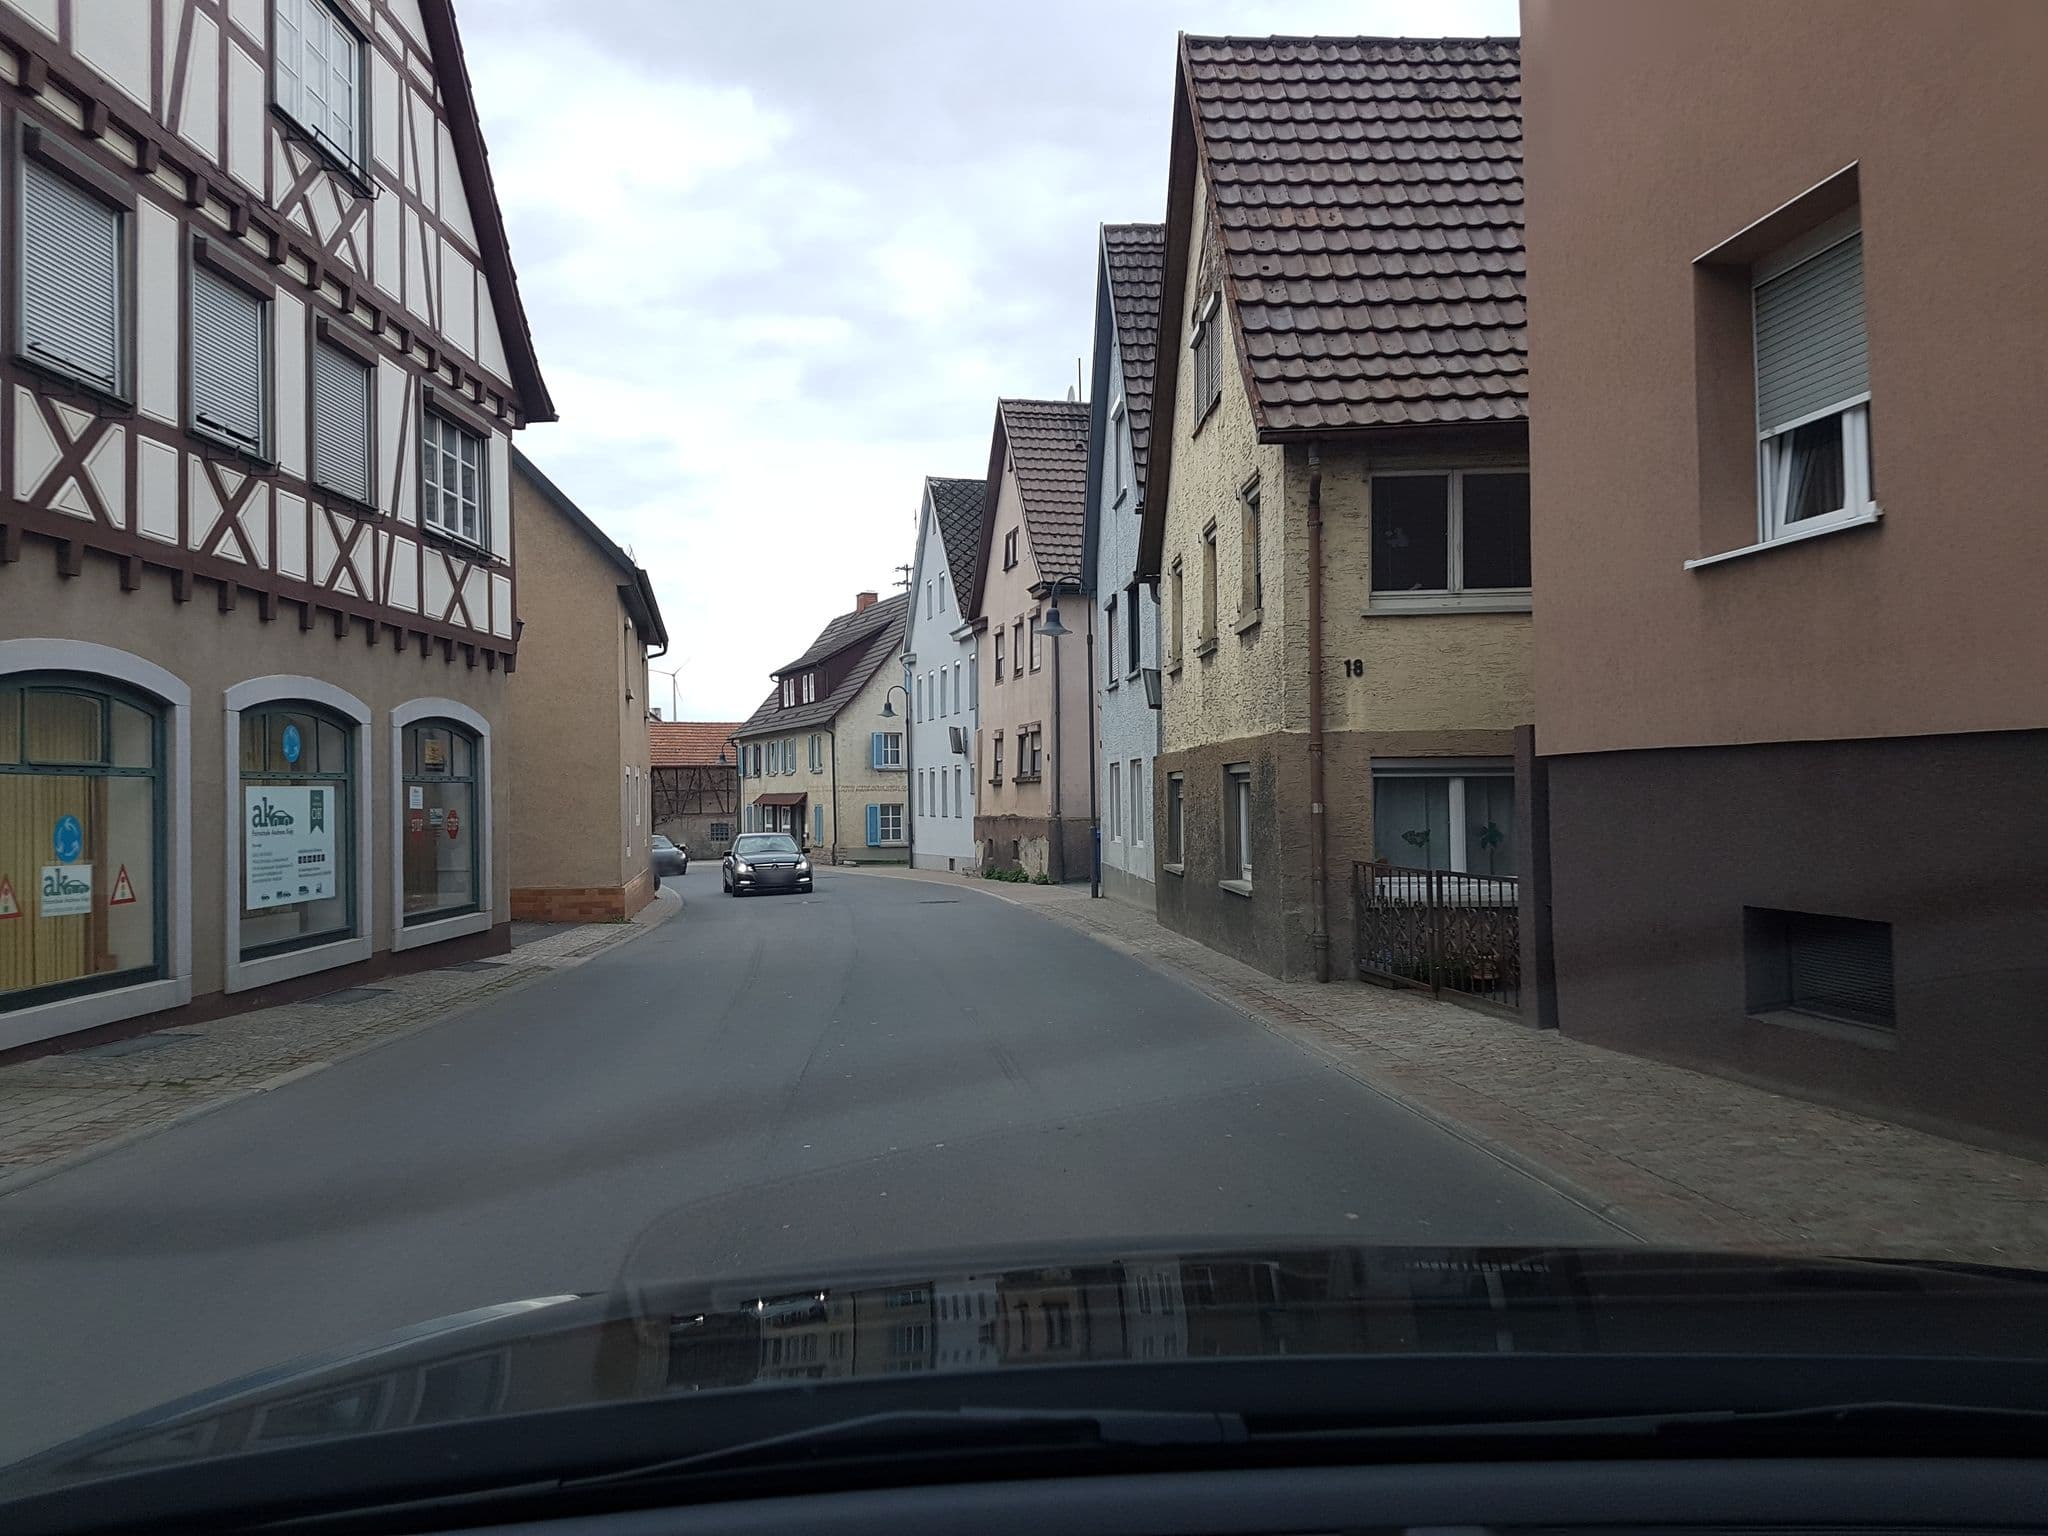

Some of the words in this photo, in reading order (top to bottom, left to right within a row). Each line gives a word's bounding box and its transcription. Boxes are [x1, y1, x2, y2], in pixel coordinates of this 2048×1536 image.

[1344, 659, 1363, 678] 18
[252, 797, 274, 828] ak
[44, 868, 68, 897] ak
